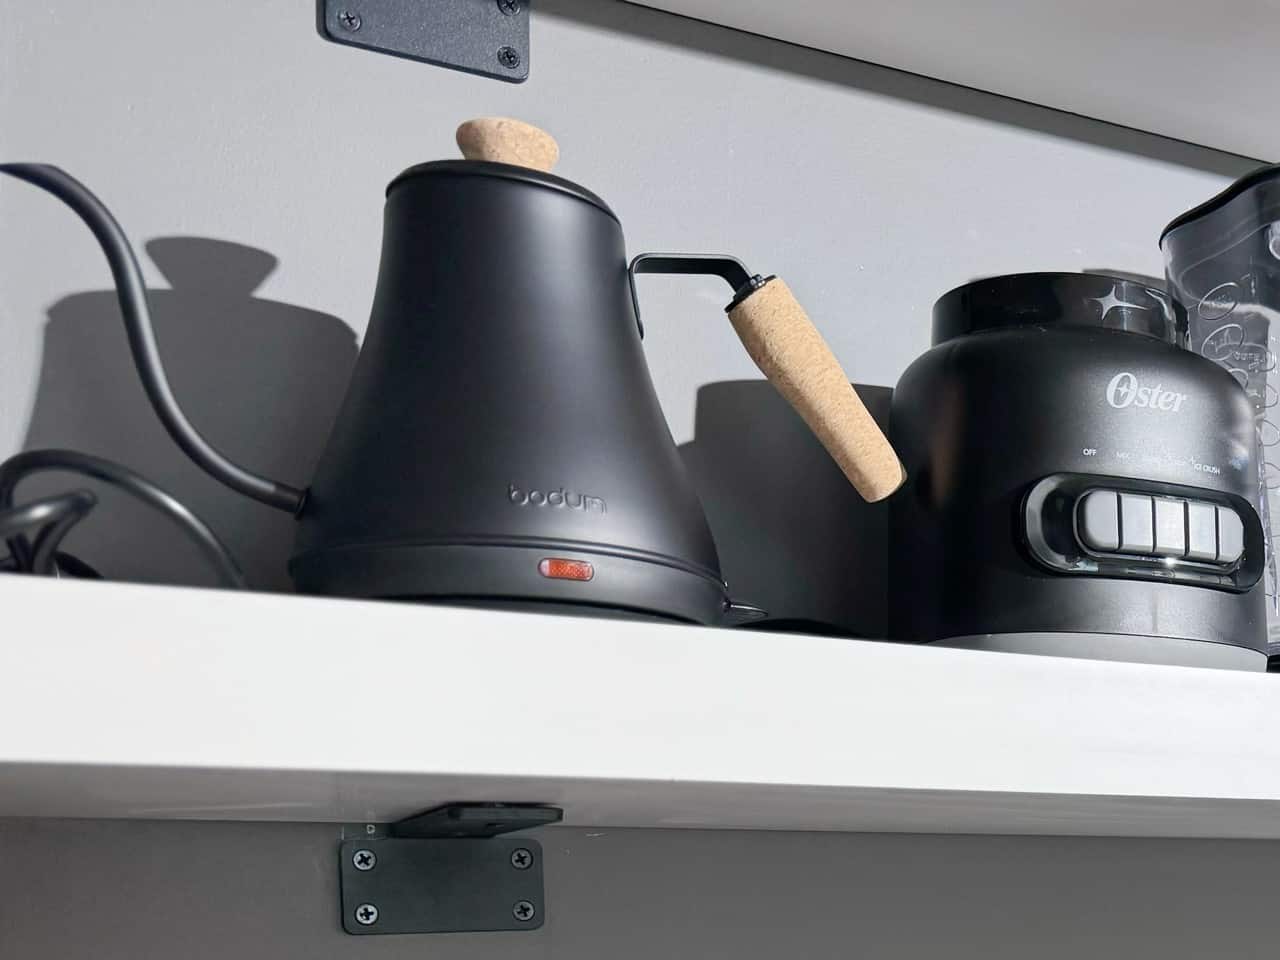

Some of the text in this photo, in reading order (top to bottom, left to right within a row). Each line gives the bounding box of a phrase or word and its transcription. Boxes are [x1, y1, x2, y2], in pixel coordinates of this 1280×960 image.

[1106, 372, 1187, 412] Oster
[1083, 448, 1097, 457] OFF
[507, 481, 607, 514] bodum
